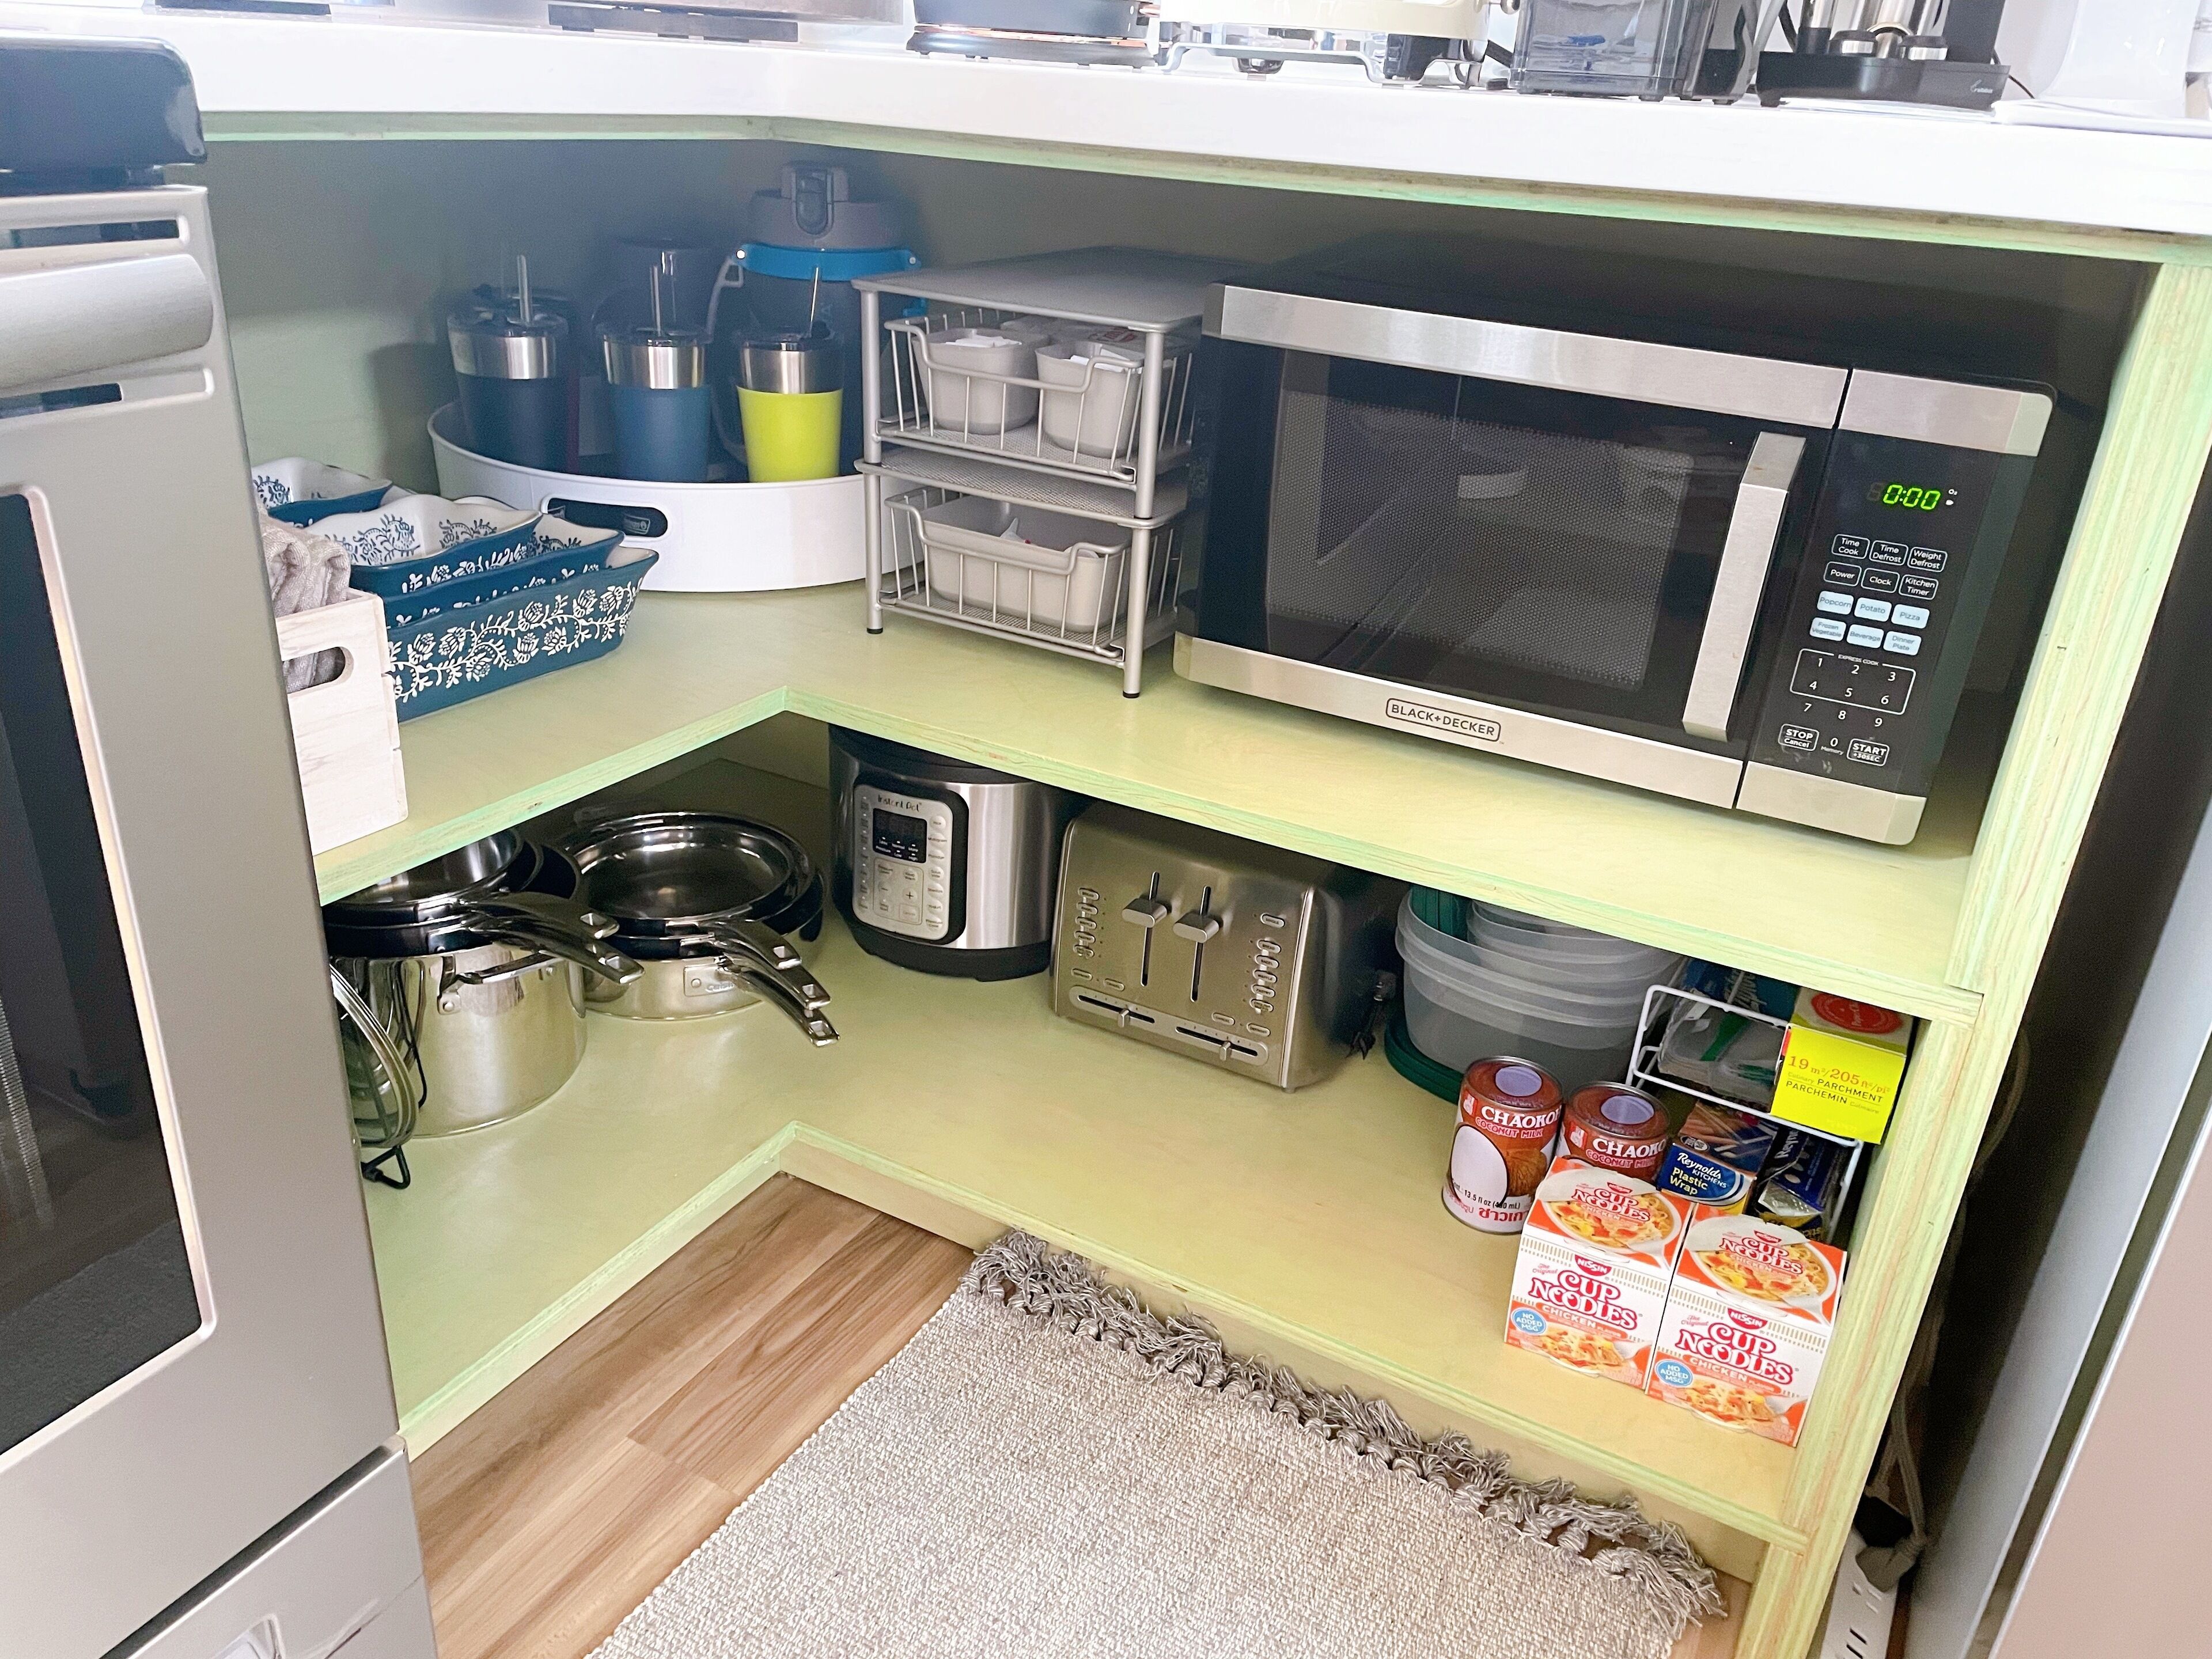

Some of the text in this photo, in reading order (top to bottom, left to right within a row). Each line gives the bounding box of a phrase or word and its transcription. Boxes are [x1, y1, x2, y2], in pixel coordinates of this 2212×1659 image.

[1883, 484, 1941, 510] 0:00
[1842, 538, 1859, 547] Time
[1838, 547, 1859, 555] Cook
[1880, 544, 1899, 554] Time
[1873, 552, 1902, 563] Defrost
[1914, 550, 1942, 560] Weight
[1911, 558, 1941, 569] Defrost
[1831, 569, 1855, 579] Power
[1869, 577, 1892, 586] Clock
[1905, 577, 1936, 588] Kitchen
[1907, 586, 1930, 596] Timer
[1820, 597, 1851, 608] Popcorn
[1860, 604, 1885, 614] Potato
[1899, 612, 1920, 621] Pizza
[1850, 631, 1880, 642] Beverage
[1892, 635, 1915, 644] Dinner
[1893, 643, 1910, 651] Plate
[1818, 658, 1823, 667] 1
[1851, 665, 1859, 675] 2
[1888, 672, 1896, 681] 3
[1809, 681, 1817, 690] 4
[1844, 688, 1853, 696] 5
[1881, 695, 1889, 704] 6
[1804, 703, 1812, 711] 7
[1391, 704, 1495, 736] BLACK+DECKER
[1838, 710, 1846, 719] 8
[1874, 718, 1883, 727] 9
[1786, 729, 1813, 740] STOP
[1784, 738, 1810, 748] Cancel
[1830, 738, 1838, 747] 0
[1852, 743, 1887, 756] START
[1788, 1056, 1809, 1070] 19
[1786, 1081, 1847, 1104] PARCHEMIN
[1817, 1078, 1884, 1103] PARCHMENT
[1475, 1116, 1543, 1139] COCONUT MILK
[1593, 1138, 1666, 1158] CHAOKO
[1586, 1149, 1633, 1168] COCONUT
[1677, 1153, 1721, 1179] Reynolds
[1673, 1167, 1708, 1190] Plastic
[1692, 1169, 1728, 1188] KITCHENS
[1670, 1176, 1698, 1195] Wrap
[1464, 1190, 1476, 1201] 13.5
[1594, 1188, 1639, 1206] CUP
[1571, 1189, 1651, 1222] NOODLES
[1479, 1207, 1529, 1222] ชาวเก
[1742, 1237, 1789, 1257] CUP
[1719, 1238, 1803, 1275] NOODLES
[1577, 1257, 1607, 1274] NISSIN
[1558, 1270, 1620, 1301] CUP
[1528, 1278, 1638, 1330] NOODLES
[1542, 1304, 1597, 1328] CHICKEN
[1730, 1311, 1763, 1327] NISSIN
[1516, 1317, 1542, 1328] ADDED
[1708, 1323, 1776, 1354] CUP
[1675, 1329, 1793, 1385] NOODLES
[1667, 1363, 1680, 1372] NO
[1690, 1358, 1748, 1382] CHICKEN
[1660, 1369, 1688, 1379] ADDED
[1665, 1375, 1684, 1384] MSG
